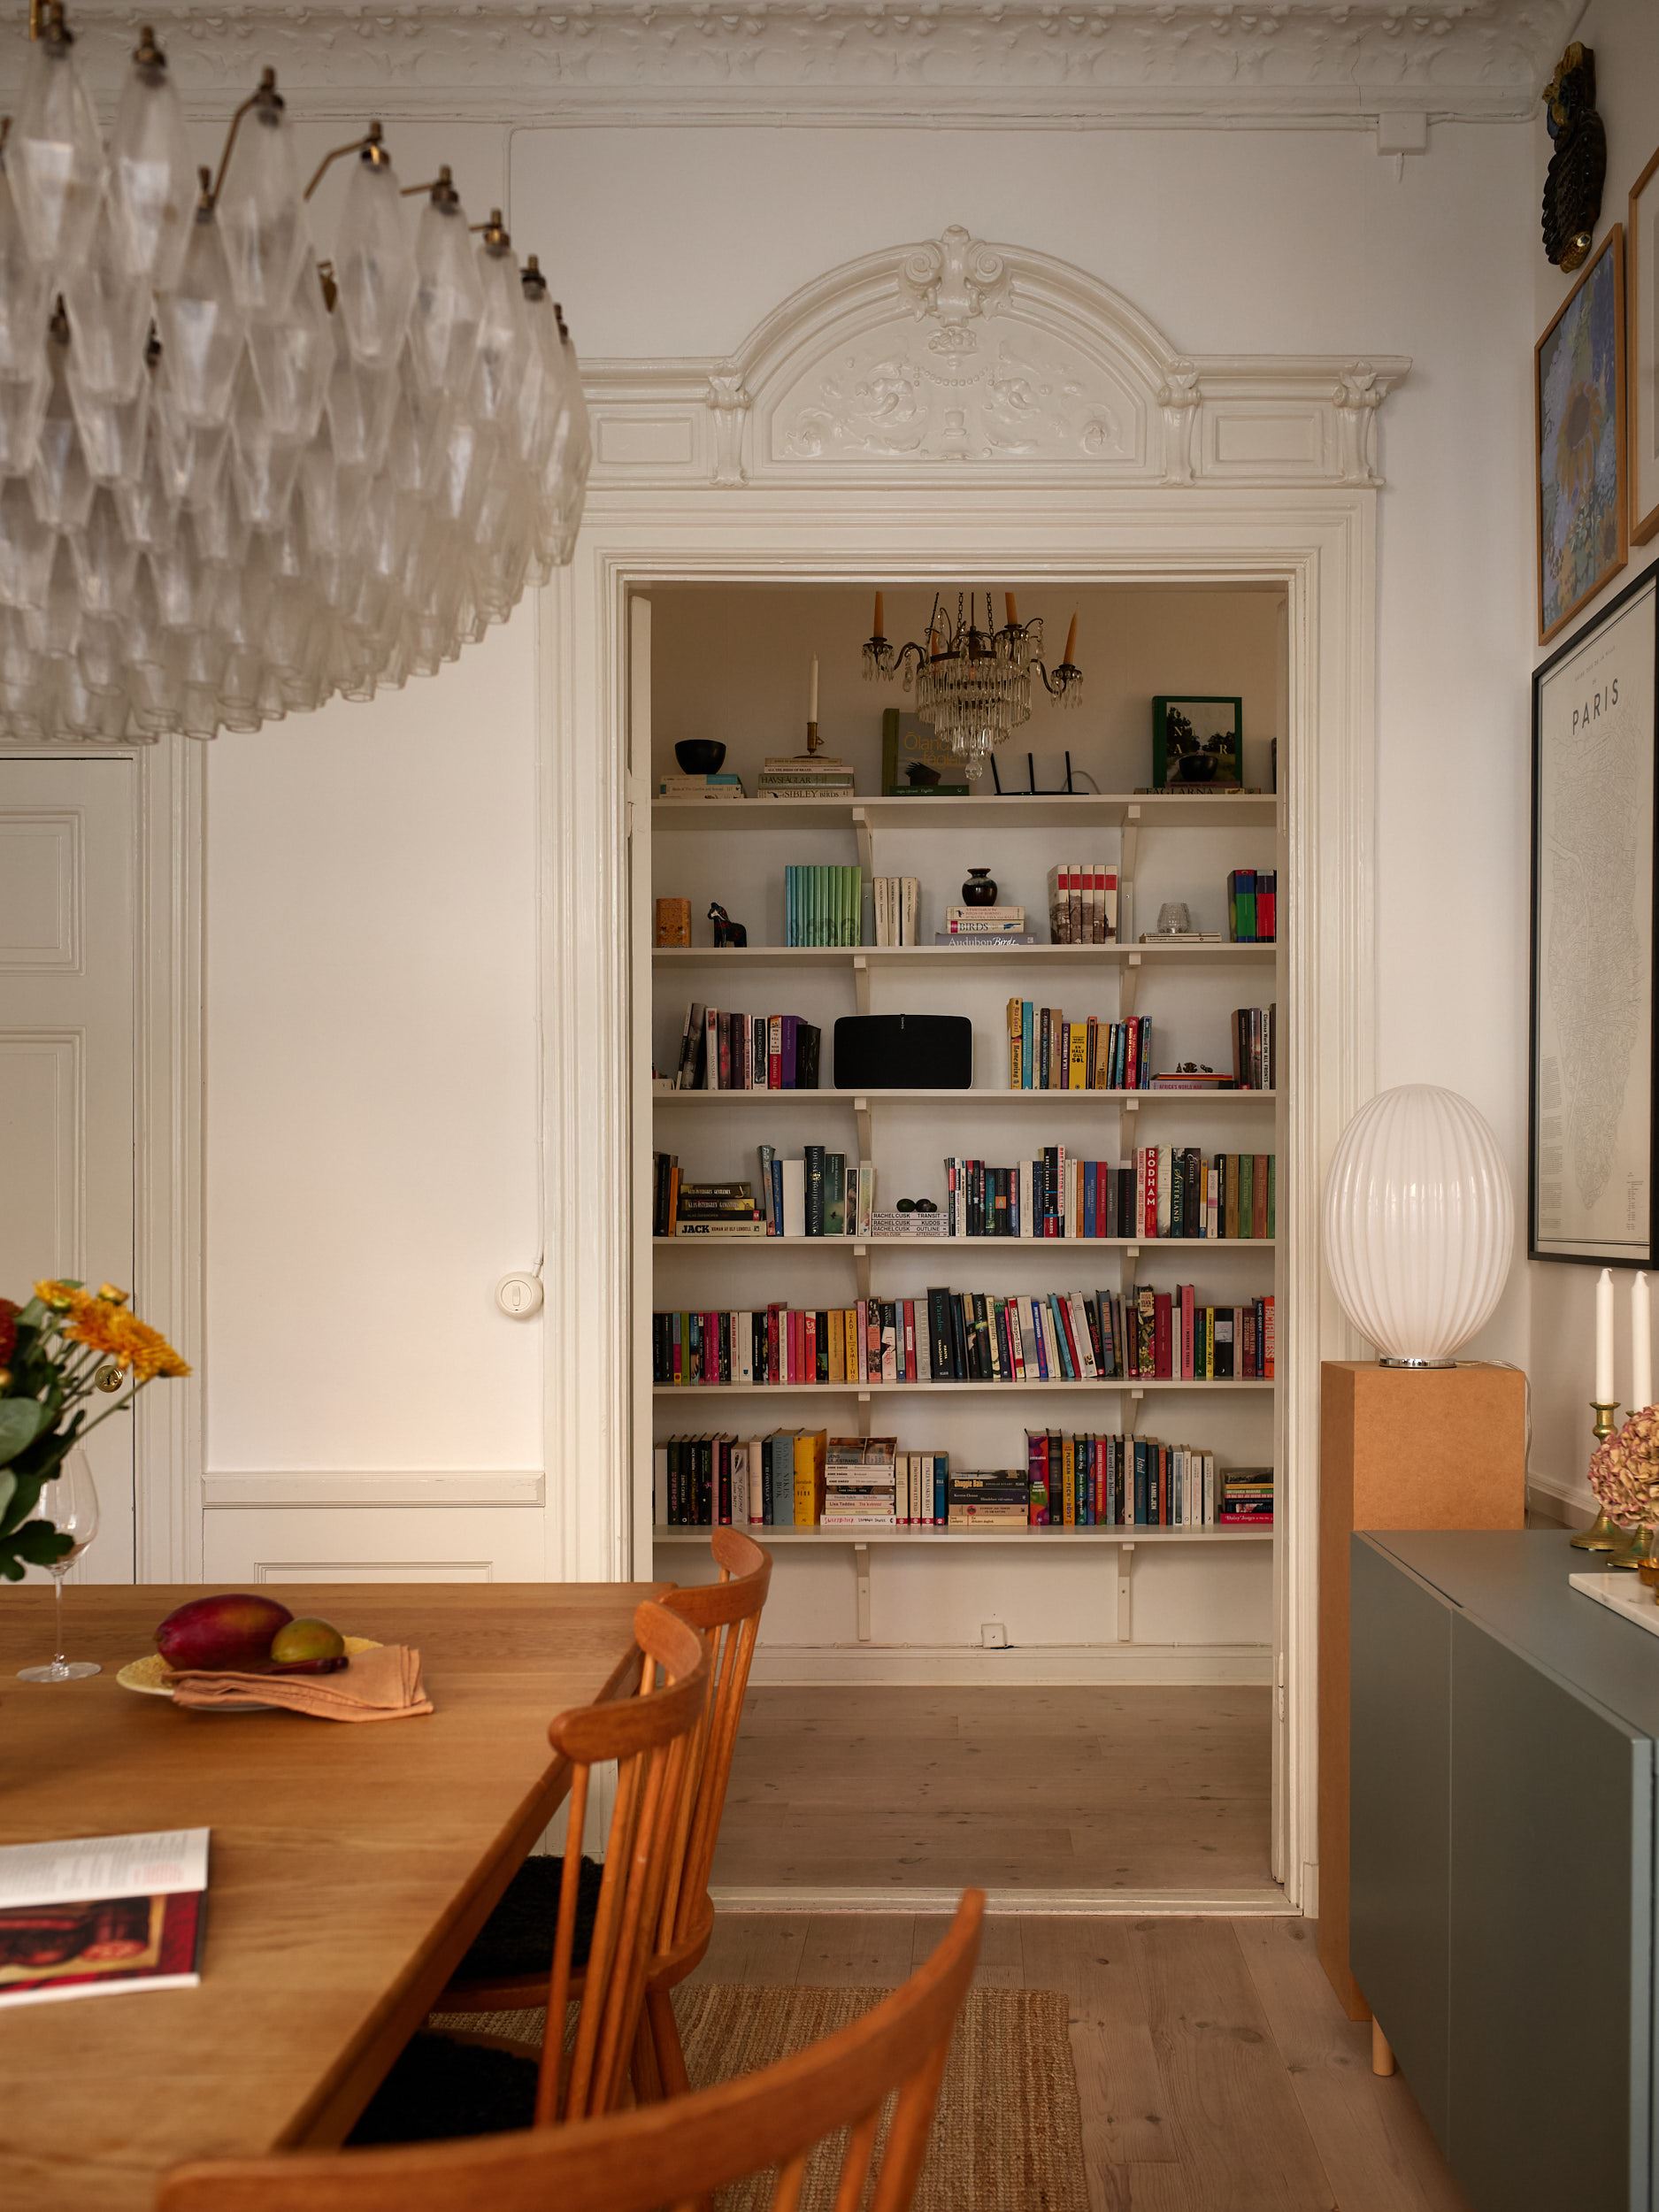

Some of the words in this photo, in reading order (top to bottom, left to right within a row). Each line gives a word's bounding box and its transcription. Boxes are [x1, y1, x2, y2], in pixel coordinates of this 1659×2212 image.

[1572, 678, 1618, 735] PARIS
[949, 936, 992, 946] Audubon
[1147, 1149, 1156, 1206] RODHAM
[1265, 1306, 1275, 1359] FACTFULNESS
